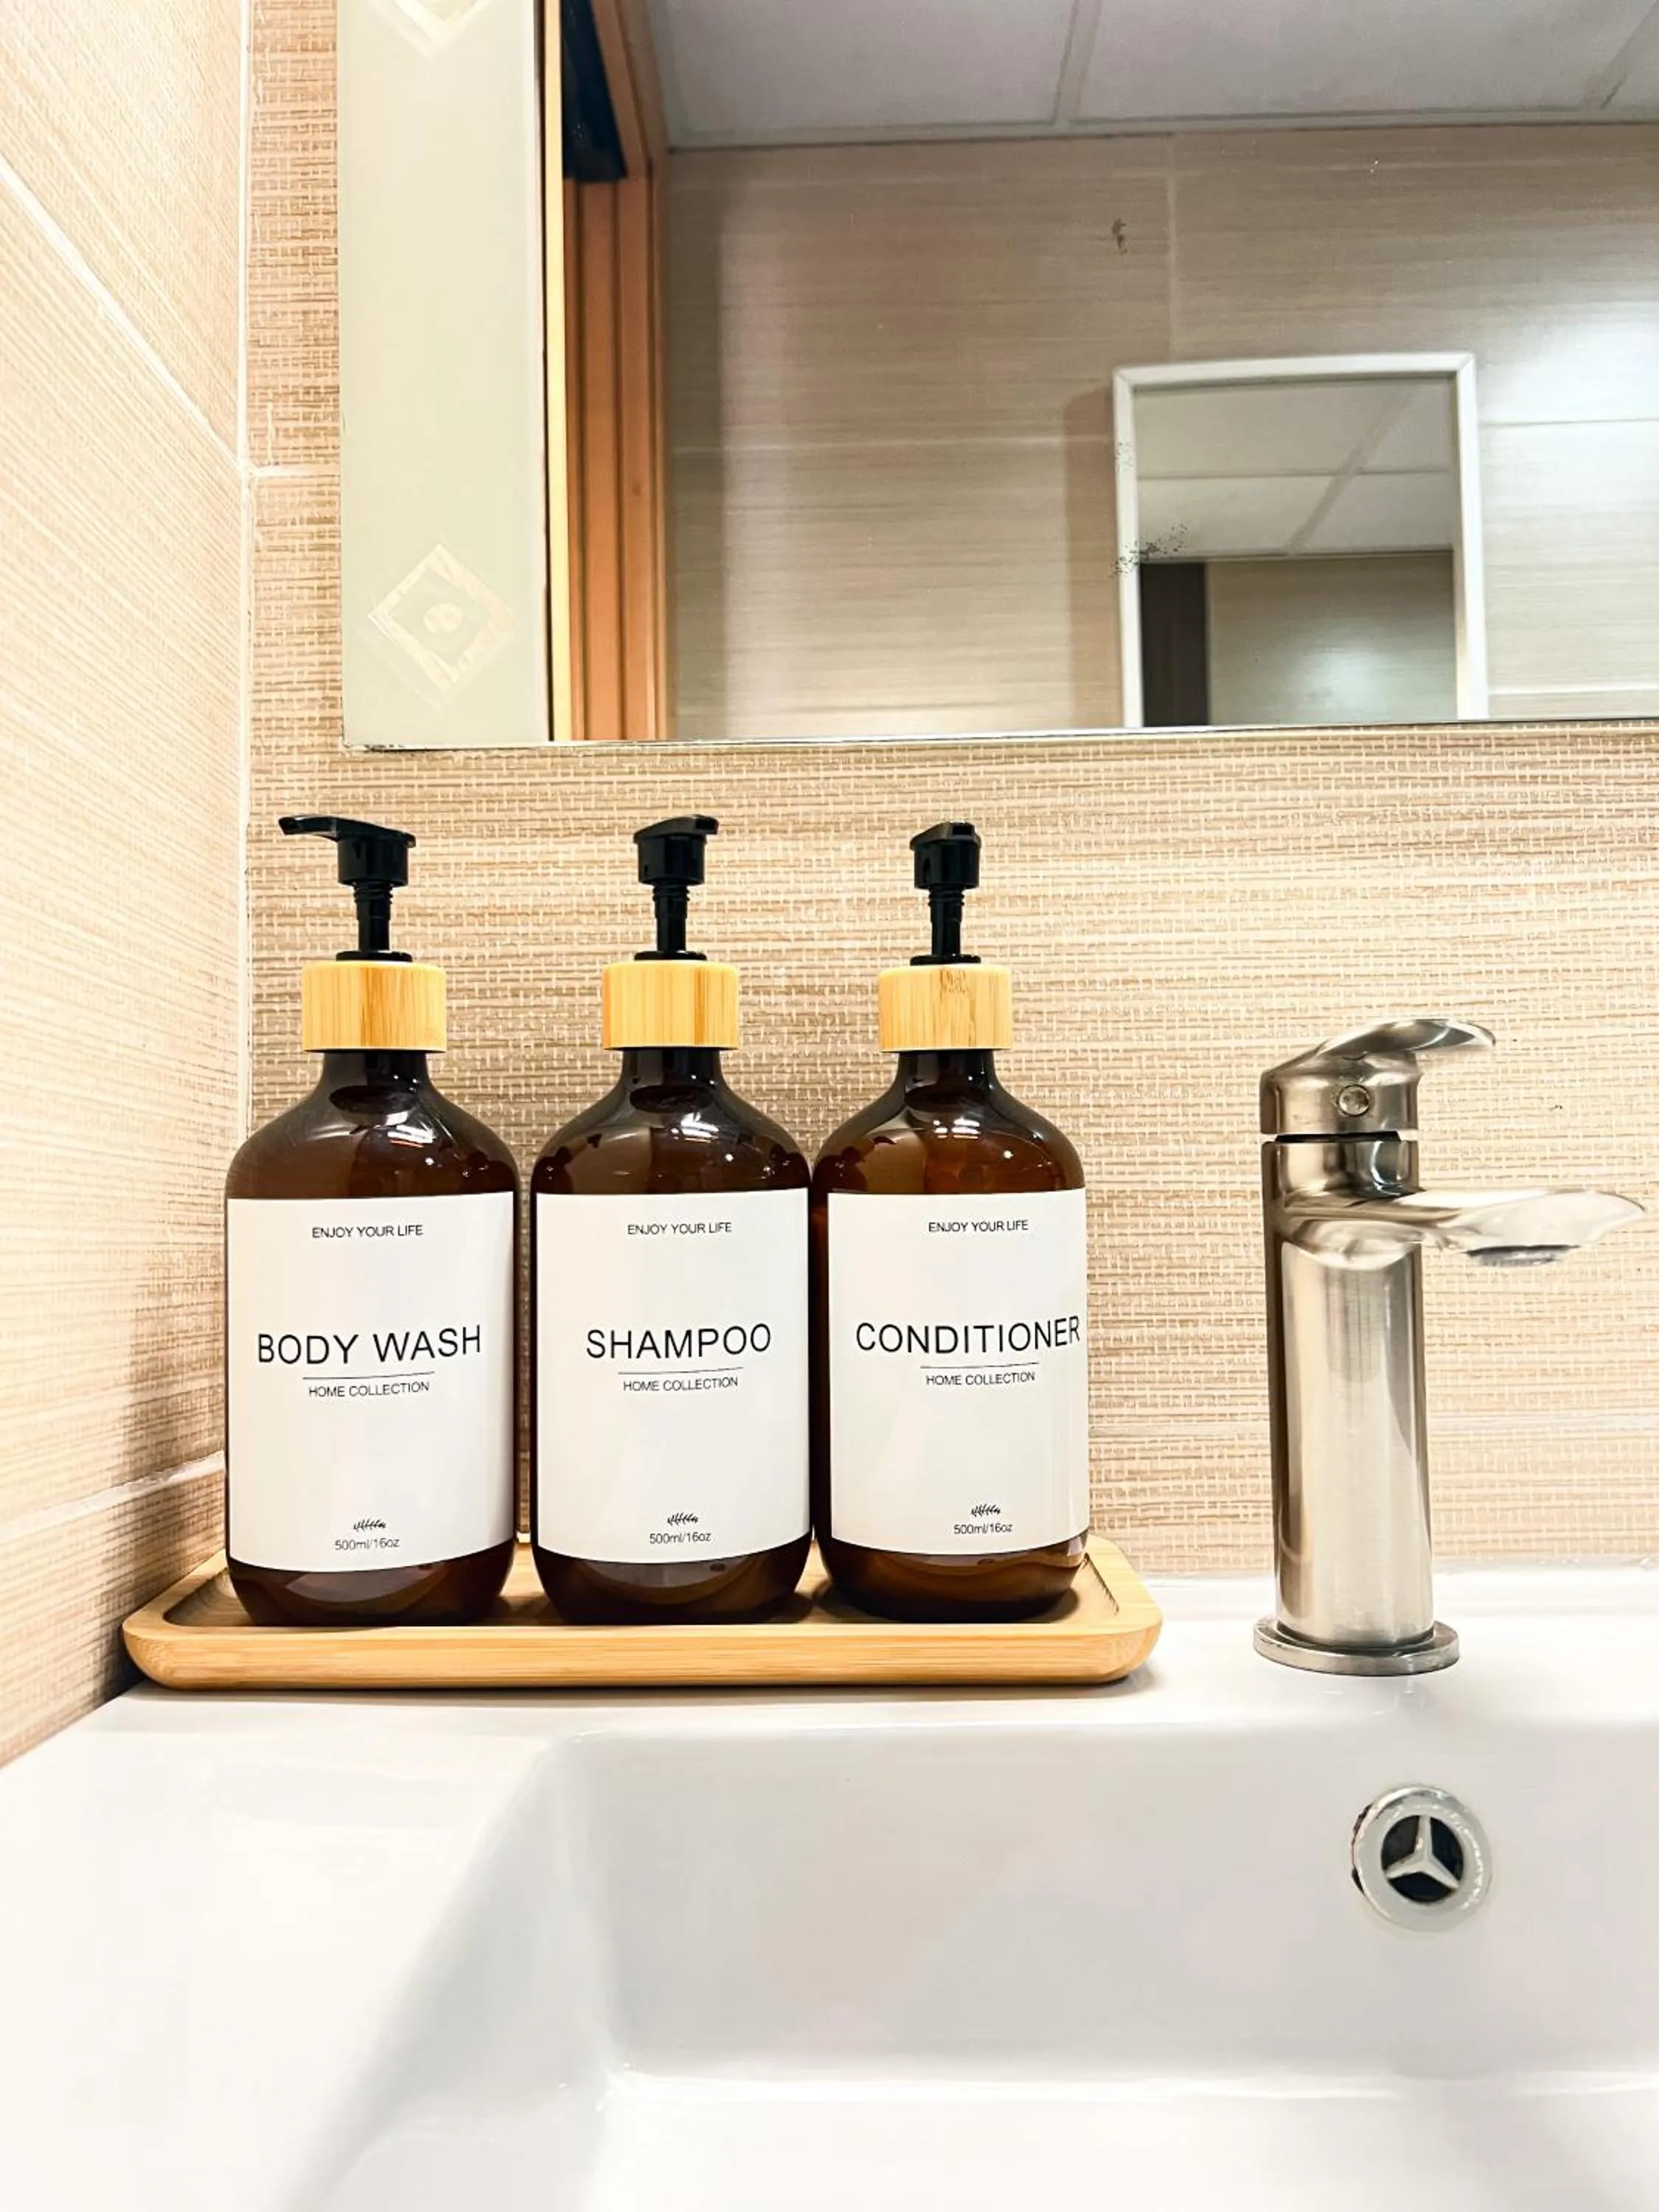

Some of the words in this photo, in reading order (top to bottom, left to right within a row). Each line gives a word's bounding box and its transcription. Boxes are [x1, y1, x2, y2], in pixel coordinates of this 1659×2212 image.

[312, 1225, 354, 1239] ENJOY
[357, 1225, 394, 1238] YOUR
[397, 1224, 424, 1237] LIFE
[627, 1223, 667, 1236] ENJOY
[669, 1222, 706, 1235] YOUR
[709, 1222, 732, 1234] LIFE
[928, 1221, 968, 1233] ENJOY
[971, 1220, 1005, 1232] YOUR
[1006, 1219, 1029, 1231] LIFE
[586, 1323, 772, 1359] SHAMPOO
[856, 1315, 1080, 1354] CONDITIONER
[257, 1333, 359, 1365] BODY
[372, 1324, 481, 1363] WASH
[622, 1380, 658, 1391] HOME
[662, 1377, 739, 1391] COLLECTION
[926, 1374, 962, 1385] HOME
[965, 1371, 1035, 1385] COLLECTION
[308, 1385, 345, 1397] HOME
[349, 1381, 429, 1397] COLLECTION
[953, 1522, 1013, 1535] 500ml/16oz
[335, 1537, 400, 1551] 500ml/16oz
[650, 1531, 713, 1545] 500ml/16oz
